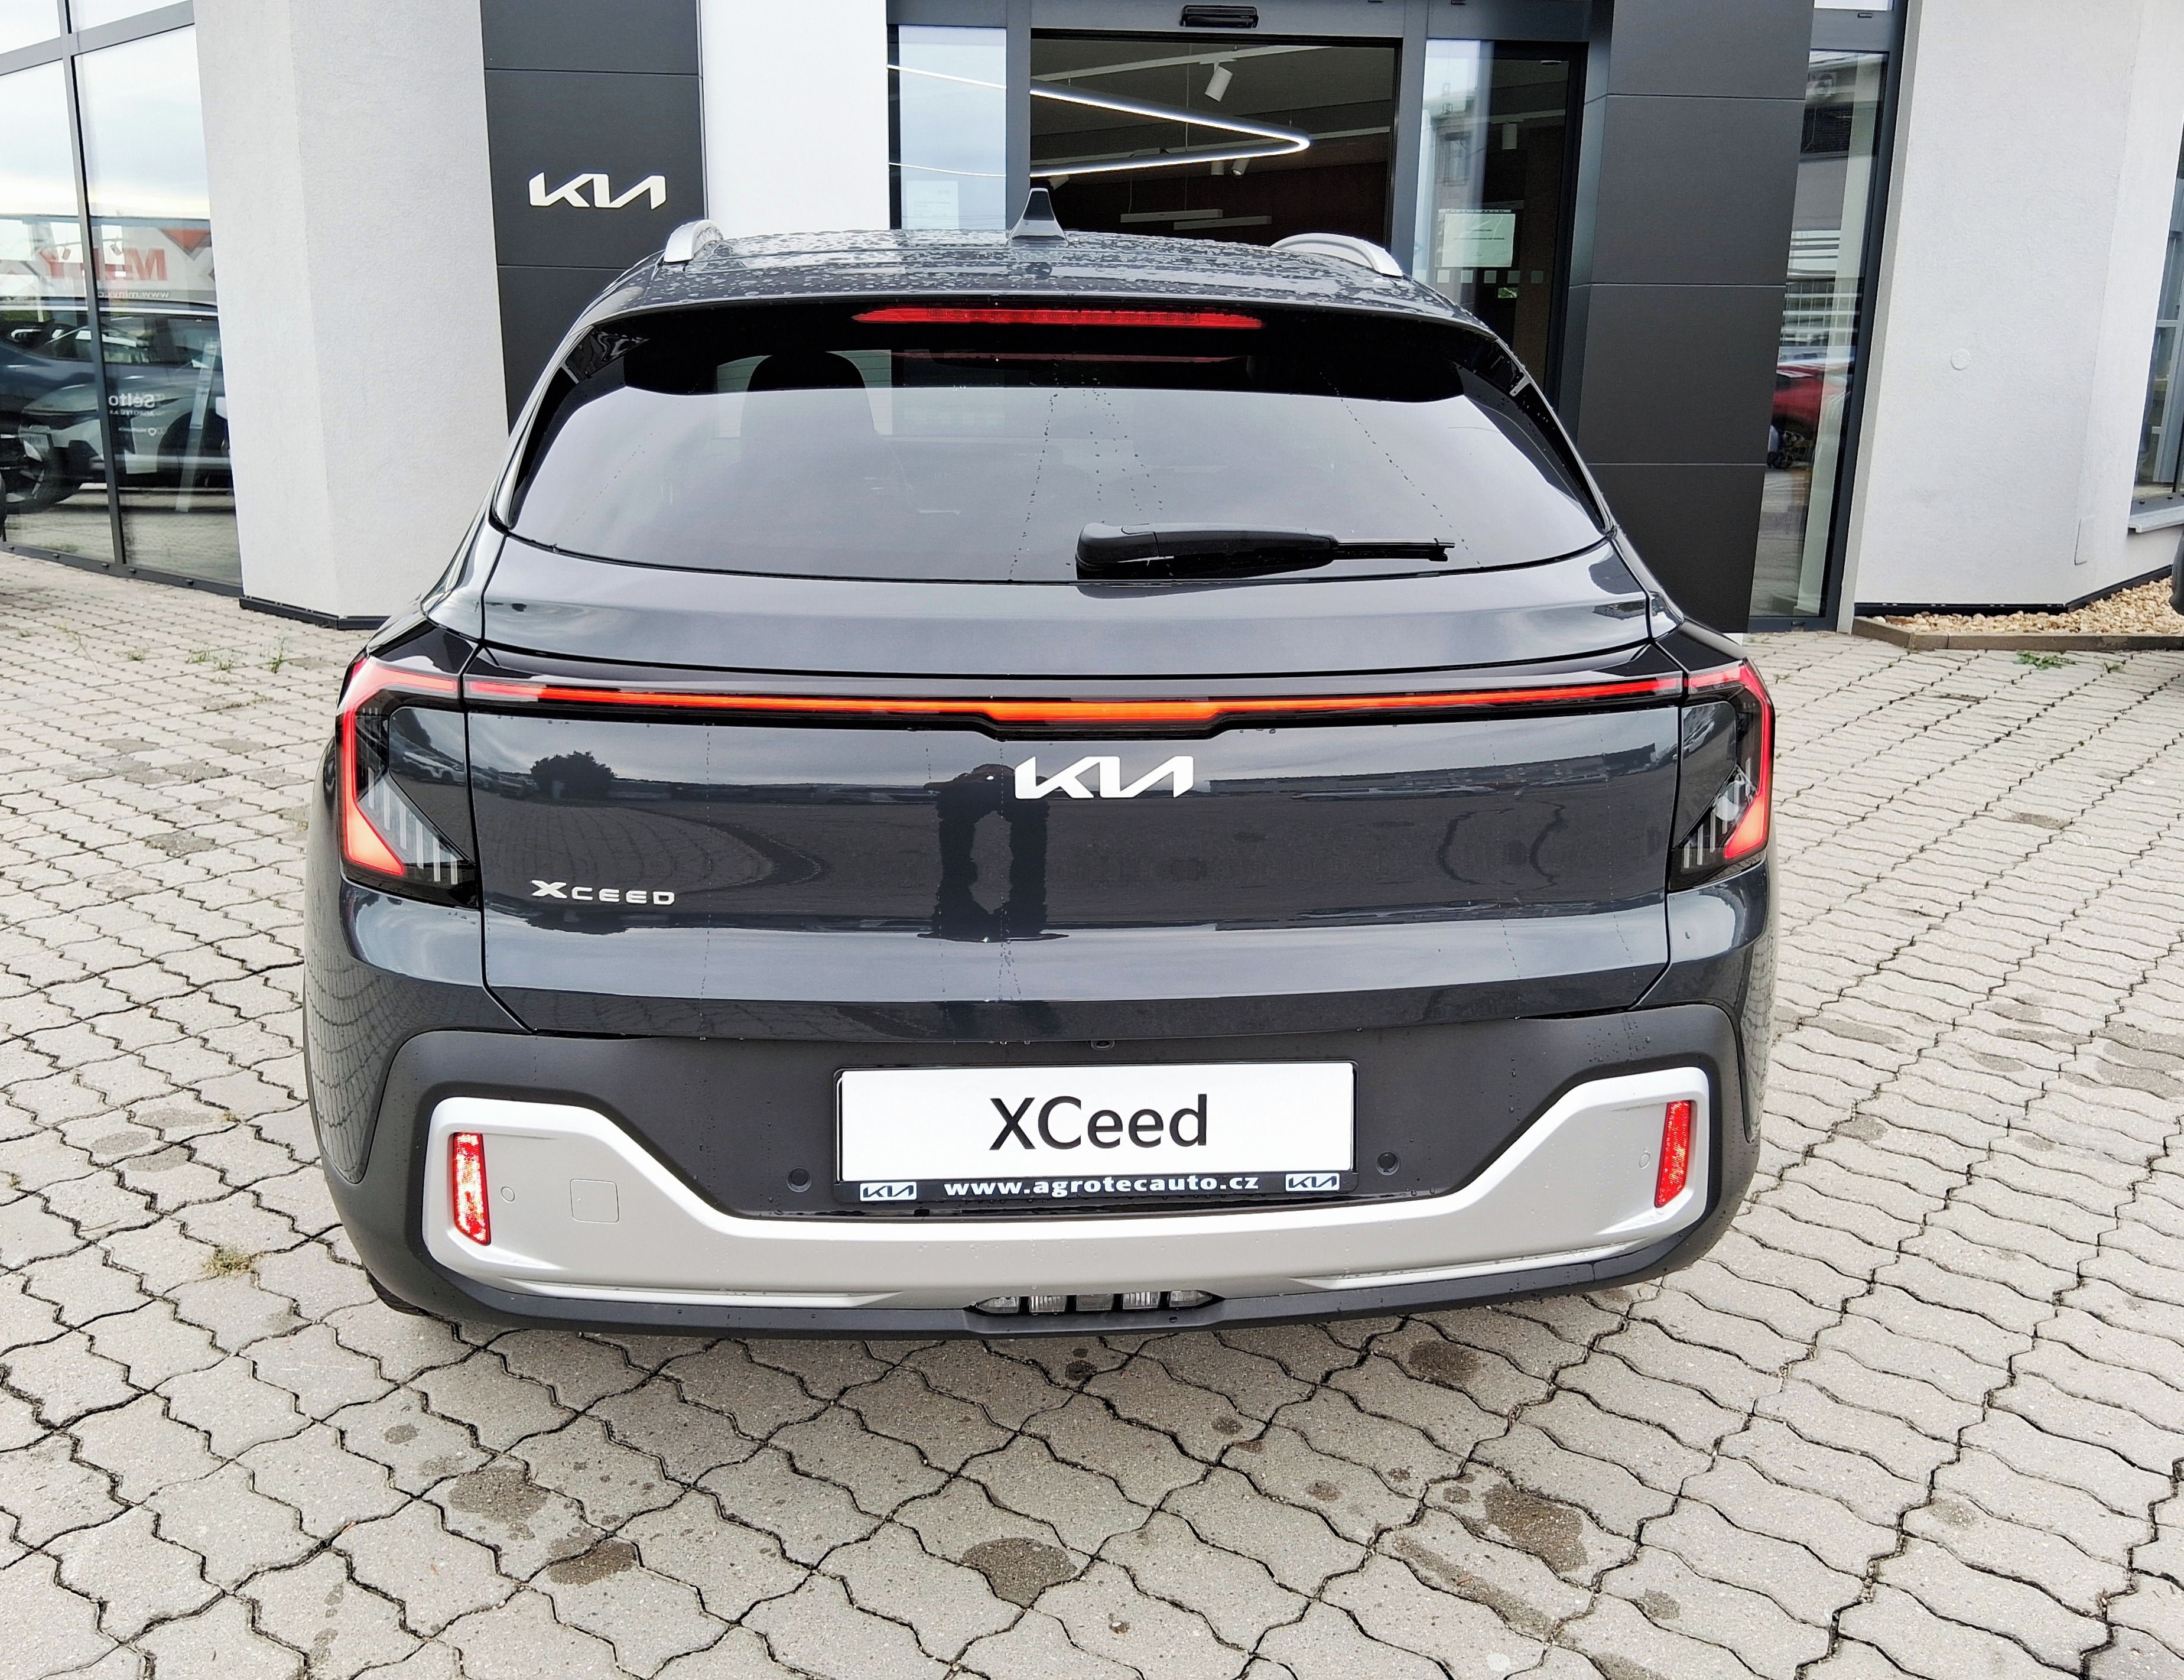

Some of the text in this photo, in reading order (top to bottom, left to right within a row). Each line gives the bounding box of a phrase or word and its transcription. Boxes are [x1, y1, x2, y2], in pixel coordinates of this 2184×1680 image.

[529, 172, 666, 210] KIA
[1015, 756, 1194, 799] KIA
[530, 880, 675, 905] XCEED
[989, 1093, 1207, 1151] XCeed
[863, 1184, 914, 1198] KIA
[944, 1175, 1259, 1197] www.agrotecauto.cz
[1288, 1175, 1337, 1188] KIA
